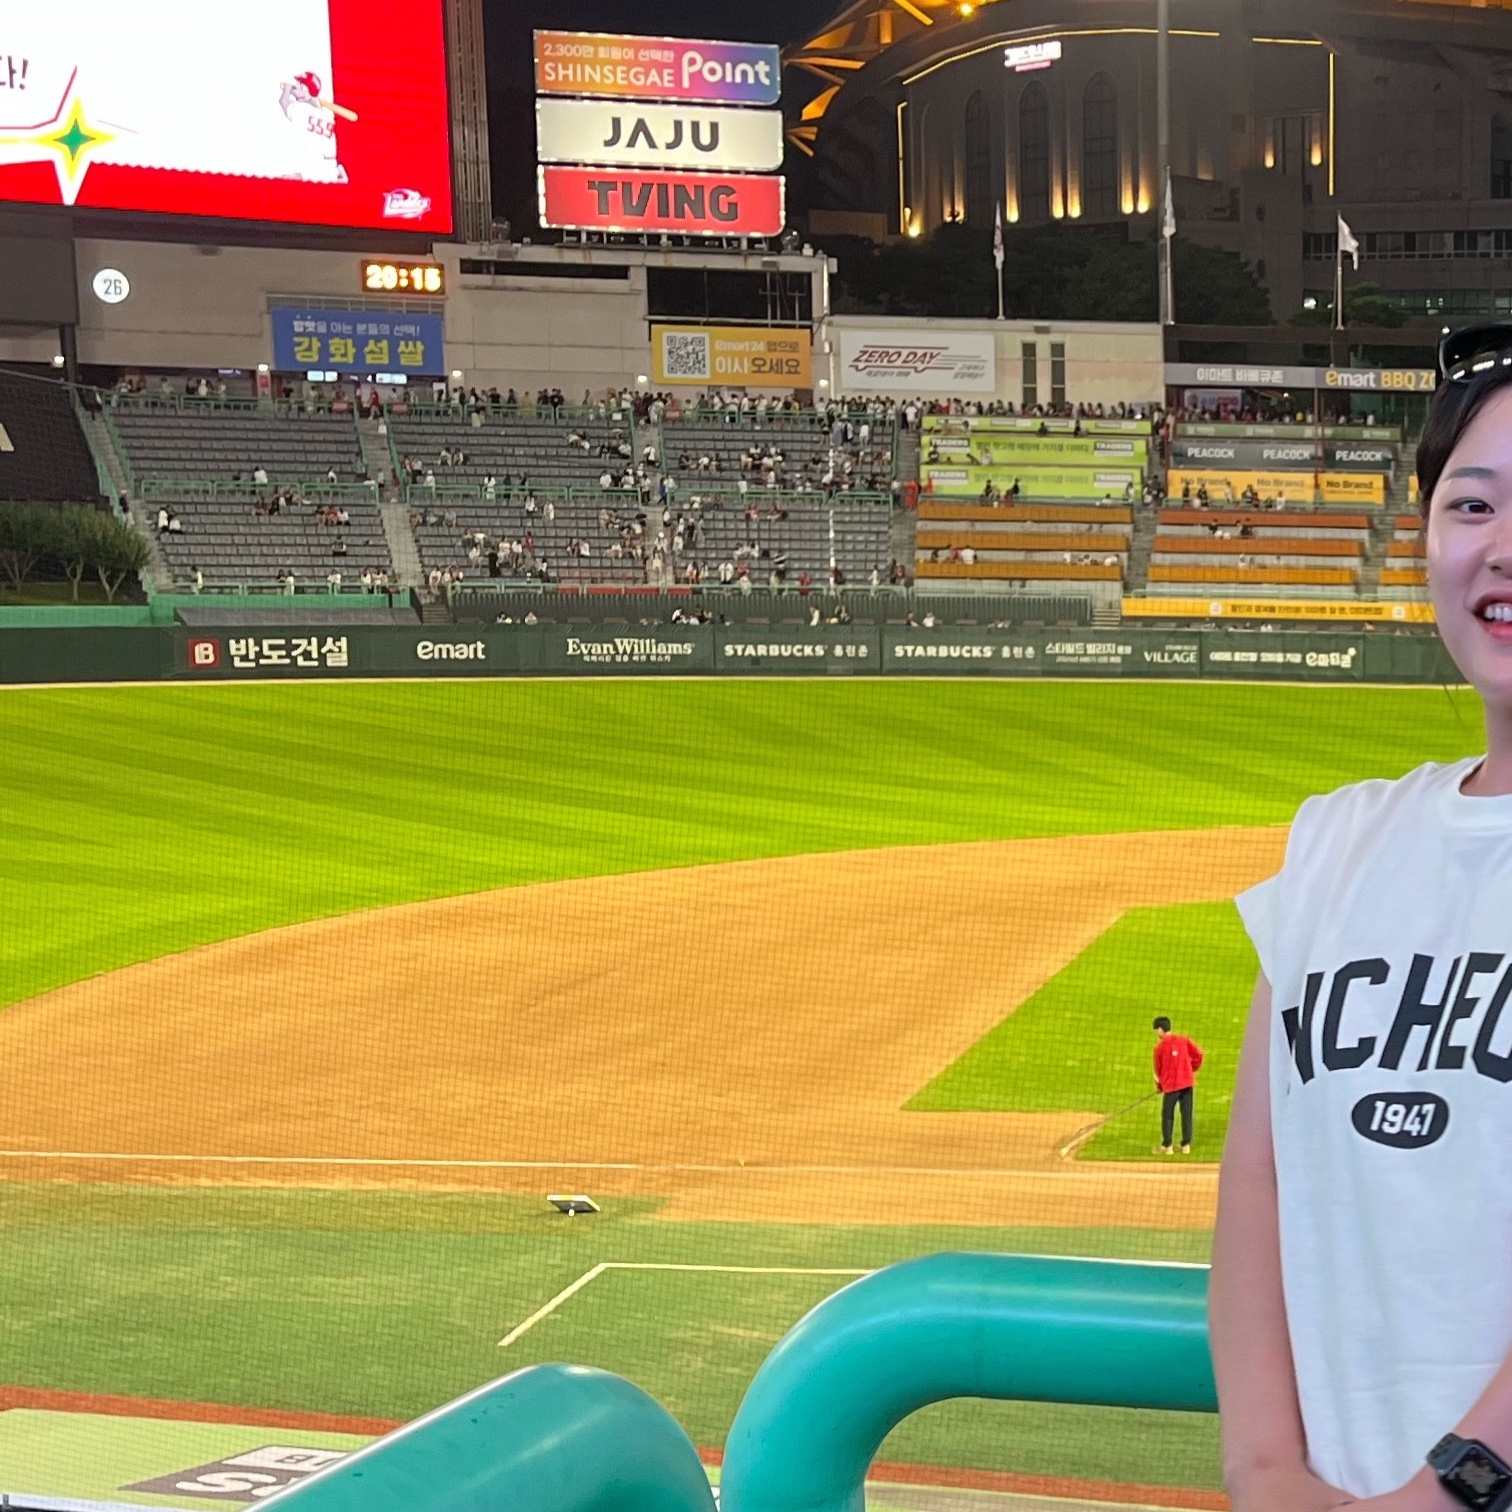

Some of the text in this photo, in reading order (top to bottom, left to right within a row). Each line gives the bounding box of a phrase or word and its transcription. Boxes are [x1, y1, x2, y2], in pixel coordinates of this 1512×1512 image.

[544, 62, 675, 87] SHINSEGAE
[682, 51, 770, 88] Point
[603, 117, 719, 152] JAJU
[587, 181, 738, 221] TVING
[103, 278, 122, 296] 26
[366, 264, 441, 291] 20:15
[852, 350, 941, 365] ZERO DAY
[1325, 370, 1376, 388] emart
[1380, 371, 1416, 389] BBQ
[1187, 447, 1235, 459] PEACOCK
[1263, 449, 1311, 461] PEACOCK
[1335, 450, 1383, 462] PEACOCK
[229, 636, 349, 668] 반도건설
[416, 640, 485, 661] emart
[724, 644, 825, 657] STARBUCKS
[894, 645, 993, 659] STARBUCKS
[1143, 651, 1198, 663] VILLAGE
[1371, 1100, 1436, 1137] 1947
